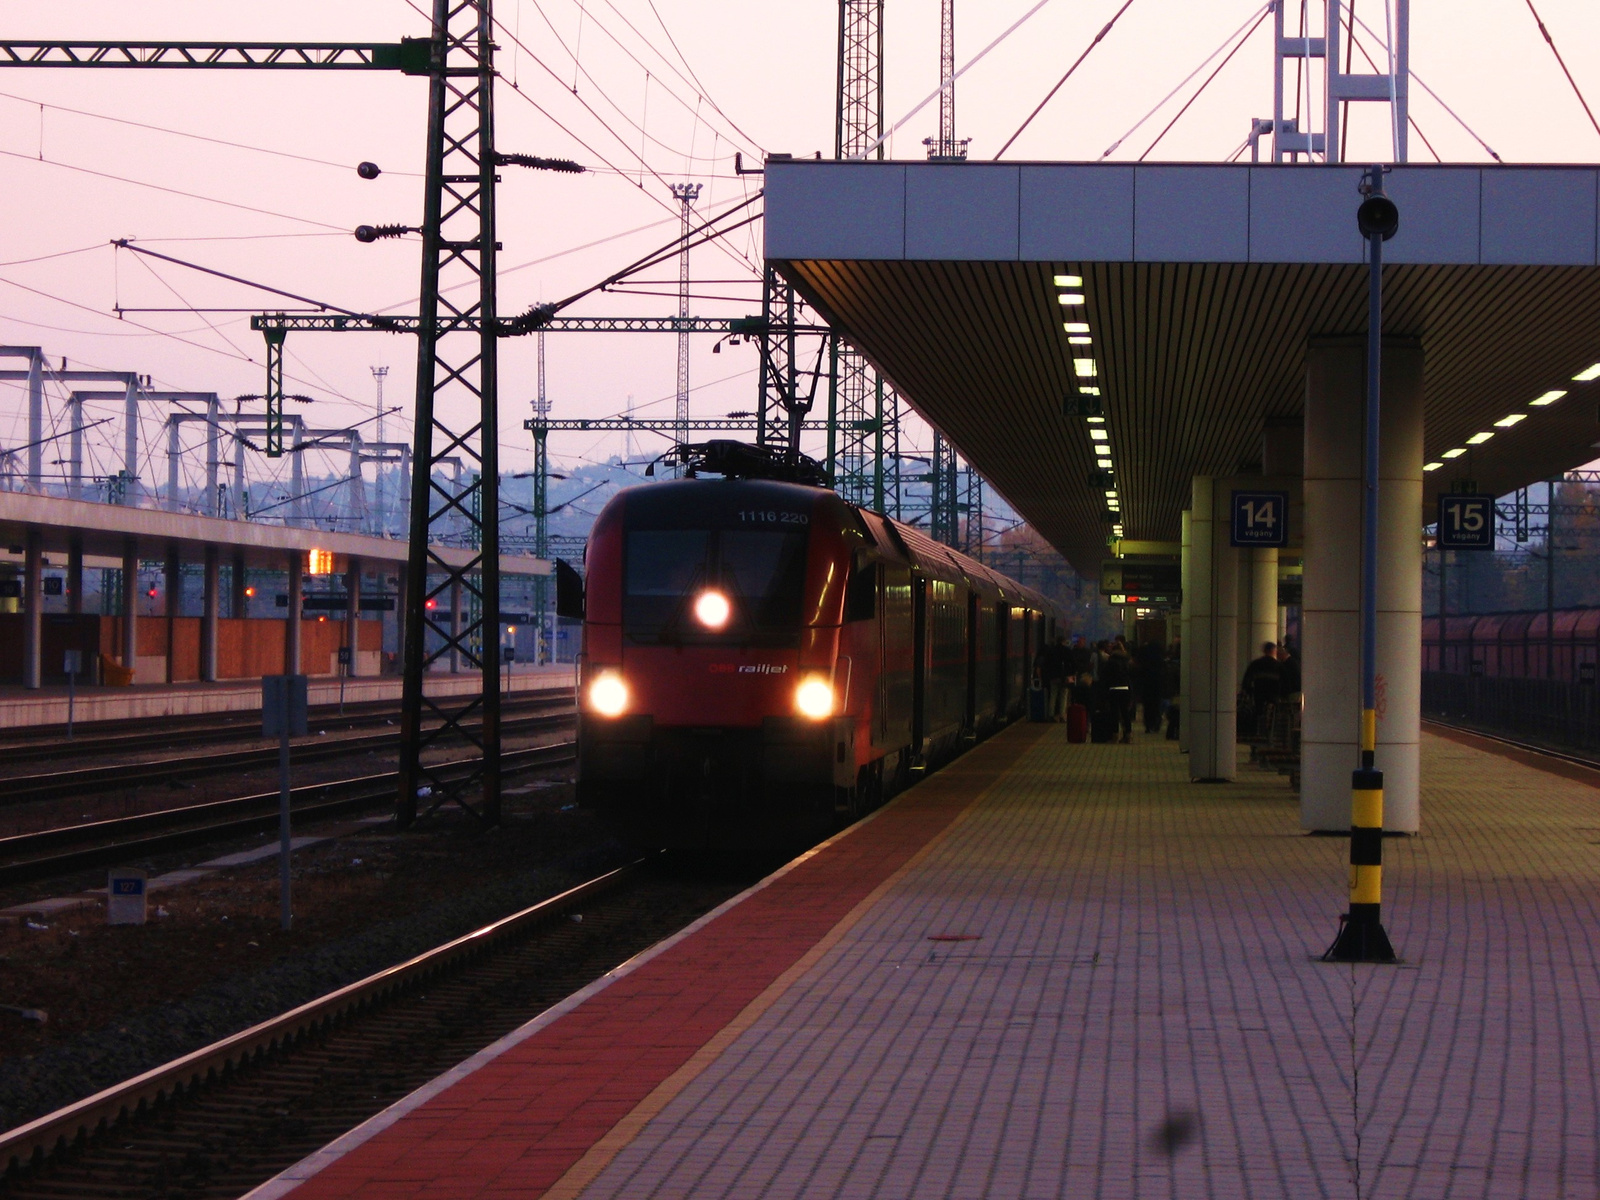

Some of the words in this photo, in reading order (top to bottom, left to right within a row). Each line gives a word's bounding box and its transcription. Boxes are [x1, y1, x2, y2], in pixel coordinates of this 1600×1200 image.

[738, 510, 777, 522] 1116
[780, 511, 808, 525] 220
[1241, 501, 1277, 528] 14
[1448, 504, 1484, 531] 15
[1245, 529, 1273, 539] vágány
[1452, 533, 1480, 541] vágány
[738, 663, 788, 675] railjet
